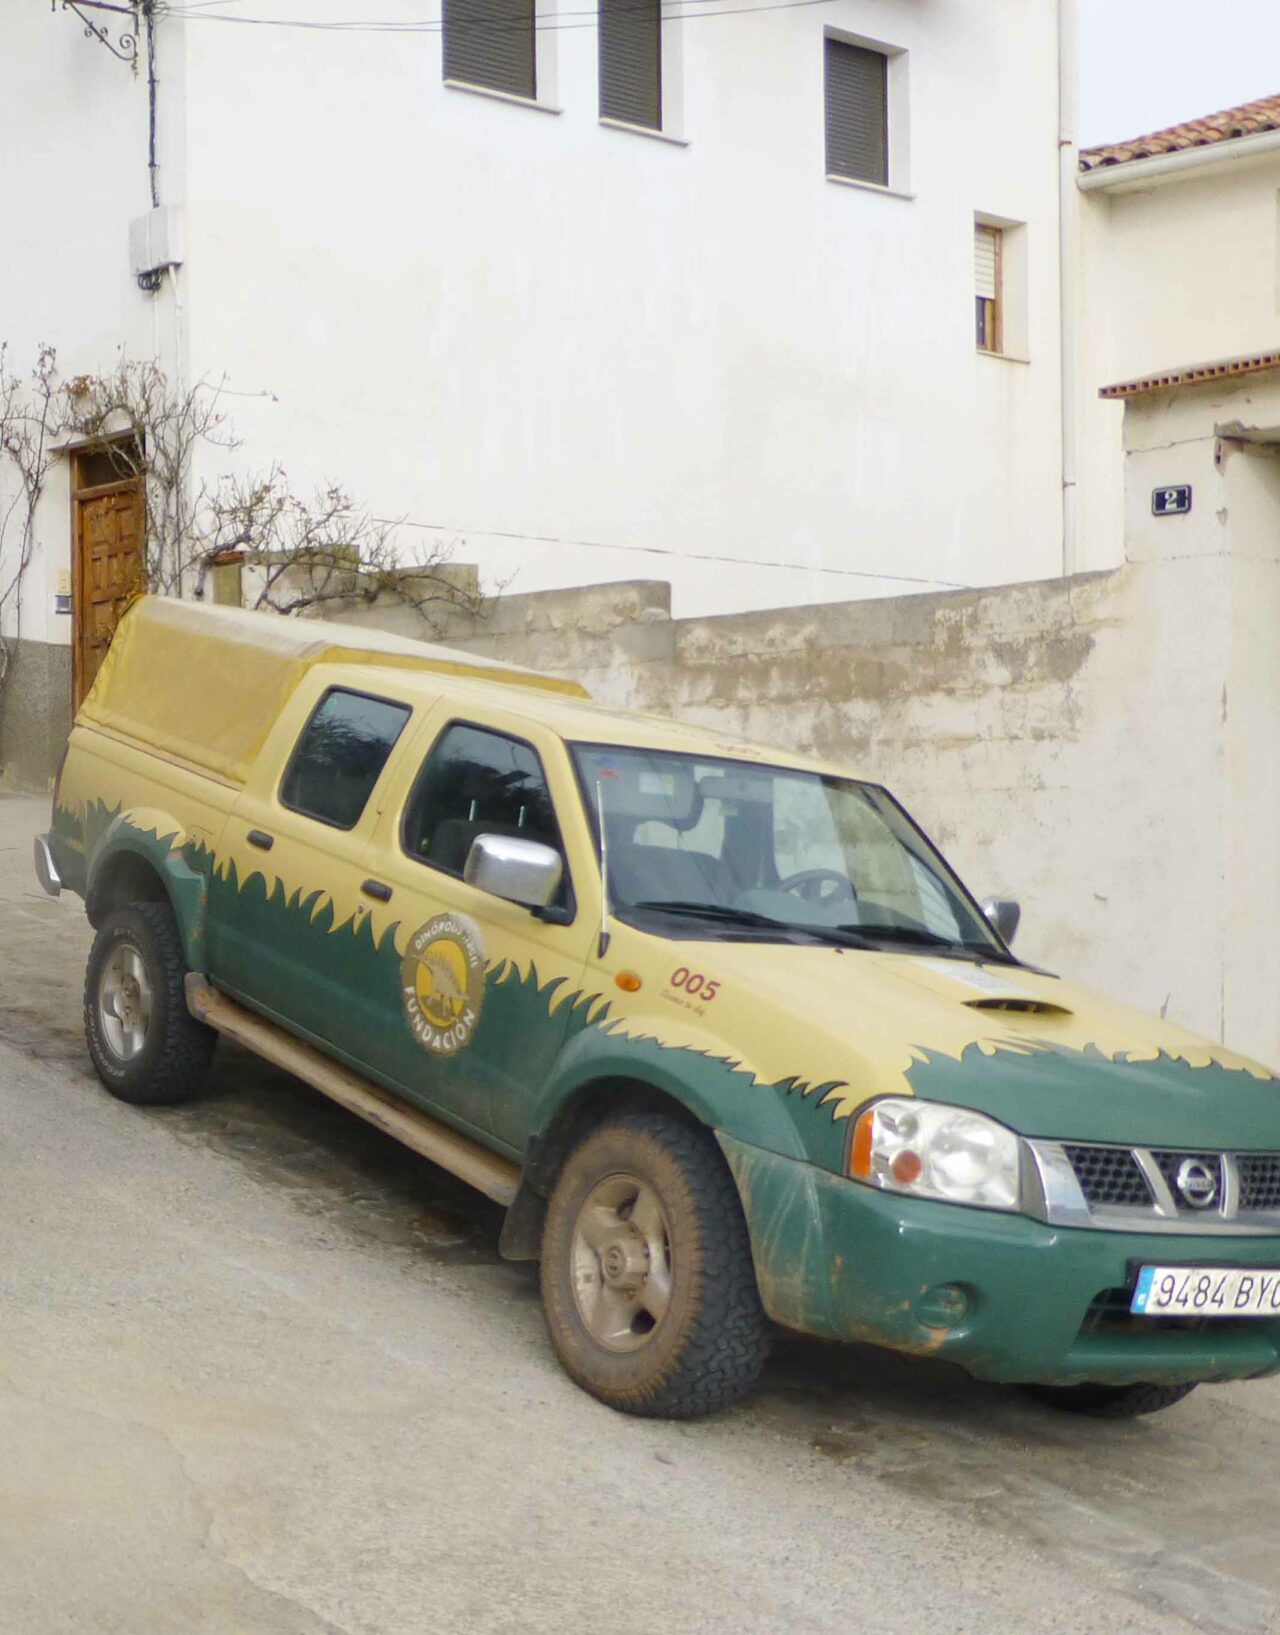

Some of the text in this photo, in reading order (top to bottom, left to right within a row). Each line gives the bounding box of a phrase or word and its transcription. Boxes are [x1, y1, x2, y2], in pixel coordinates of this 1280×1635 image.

[1164, 489, 1178, 511] 2
[670, 967, 721, 1001] 005
[1156, 1274, 1228, 1309] 9484
